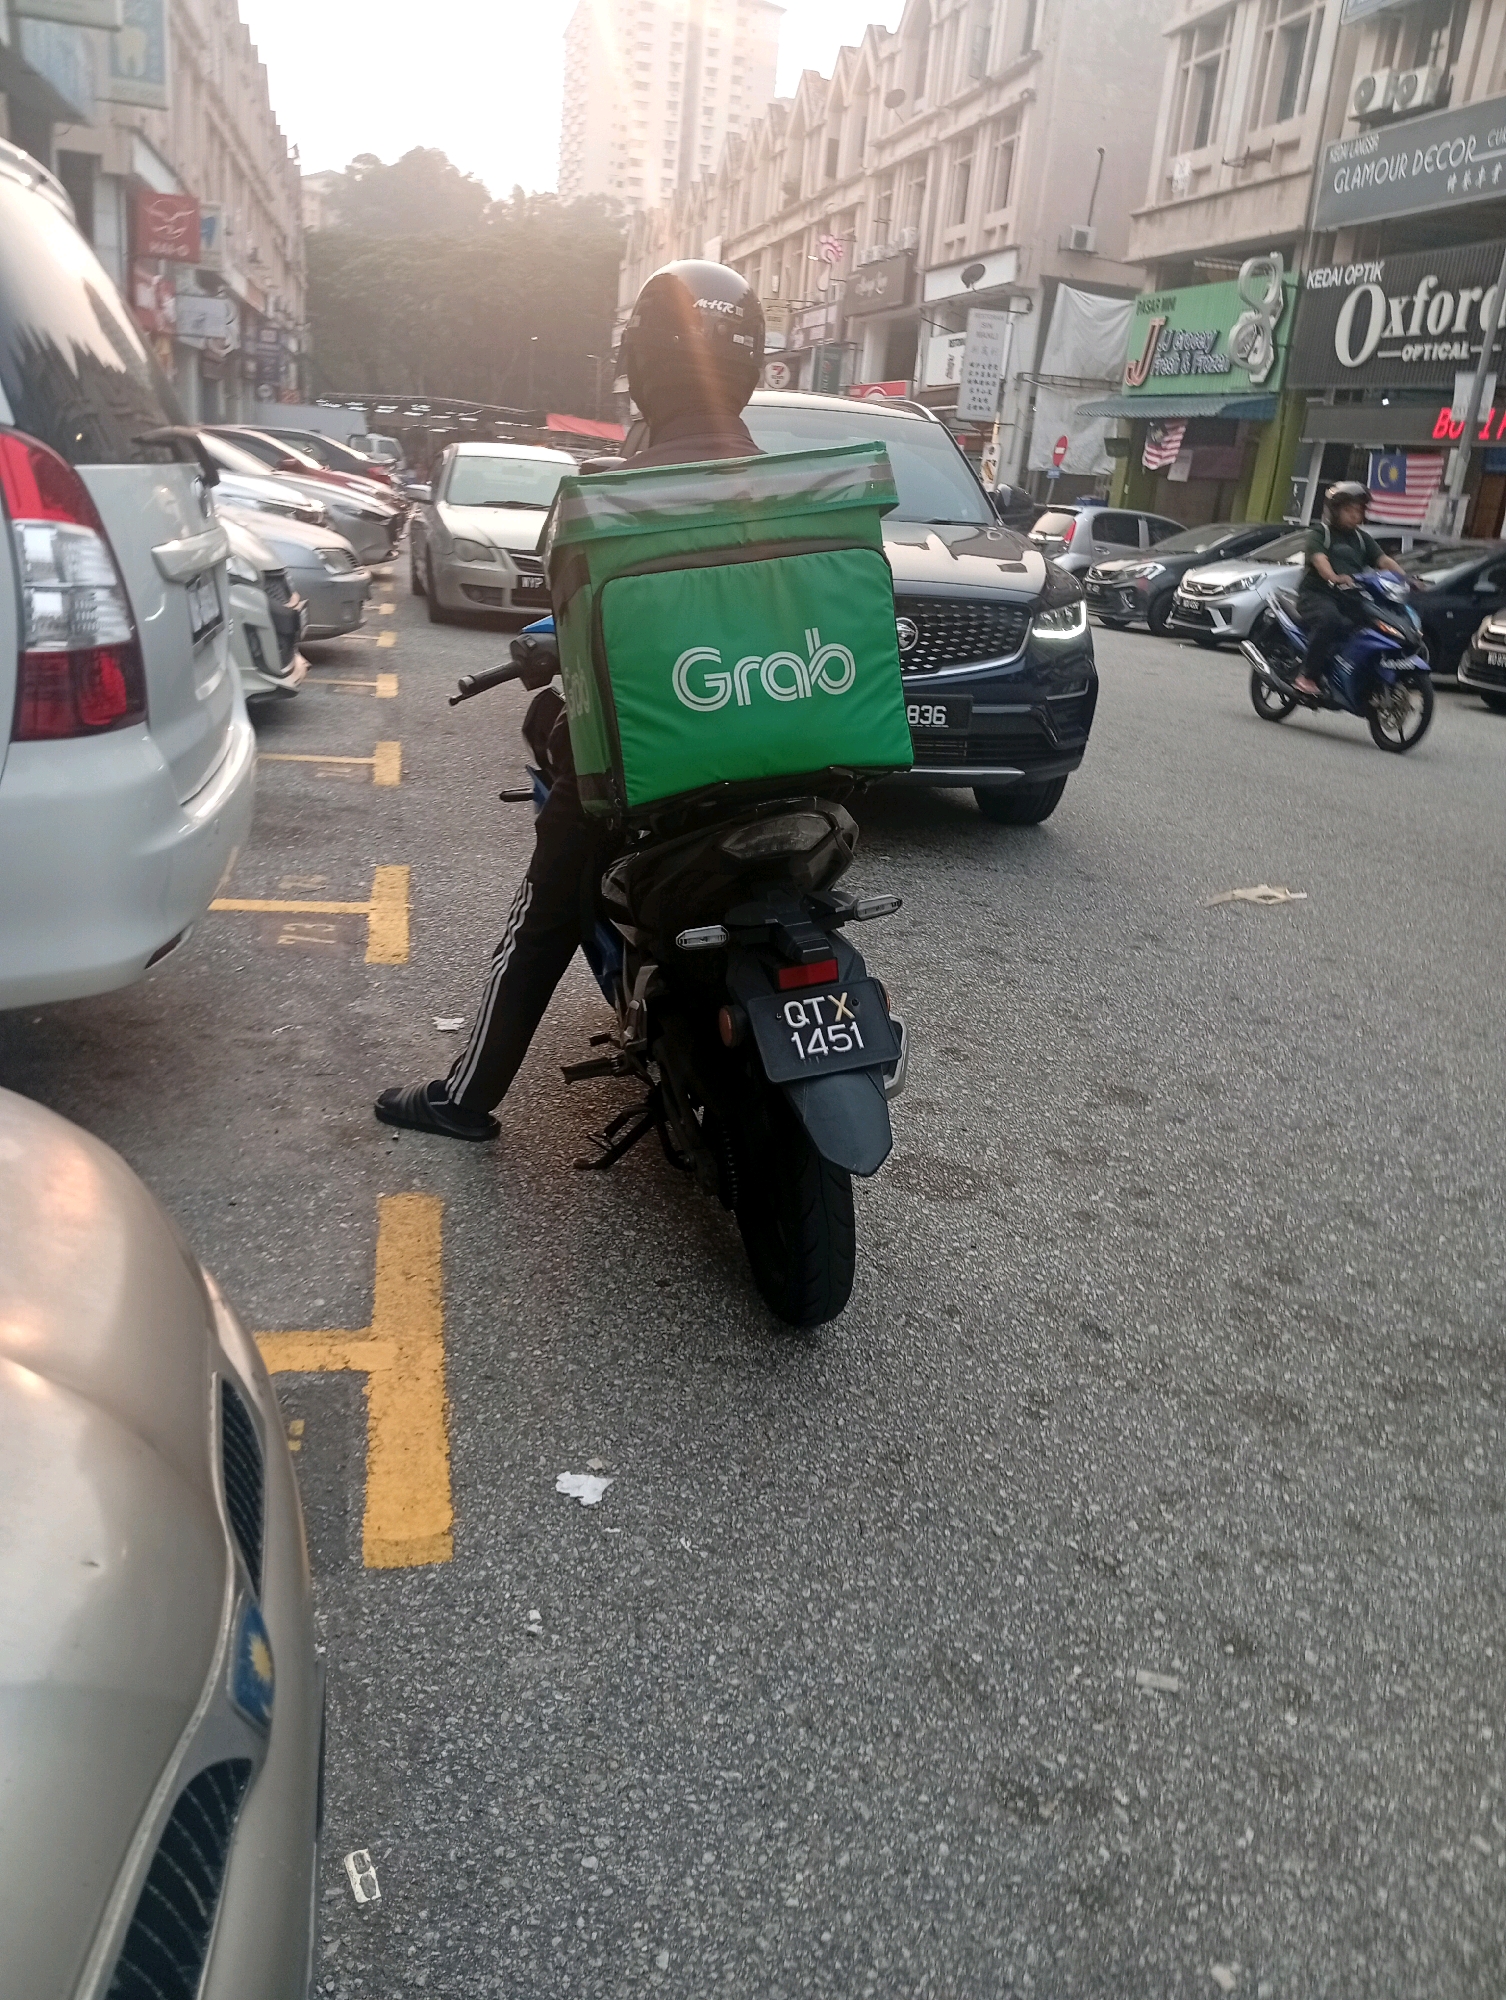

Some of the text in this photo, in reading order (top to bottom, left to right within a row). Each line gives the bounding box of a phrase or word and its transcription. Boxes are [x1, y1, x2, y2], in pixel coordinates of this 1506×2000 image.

[1333, 152, 1408, 194] GLAMOUR
[1411, 134, 1478, 176] DECOR
[1306, 259, 1385, 289] KEDAI OPTIK
[1401, 341, 1470, 362] OPTICAL
[672, 627, 856, 712] Grab
[906, 704, 948, 725] 836
[783, 991, 856, 1029] QTX
[790, 1020, 865, 1060] 1451
